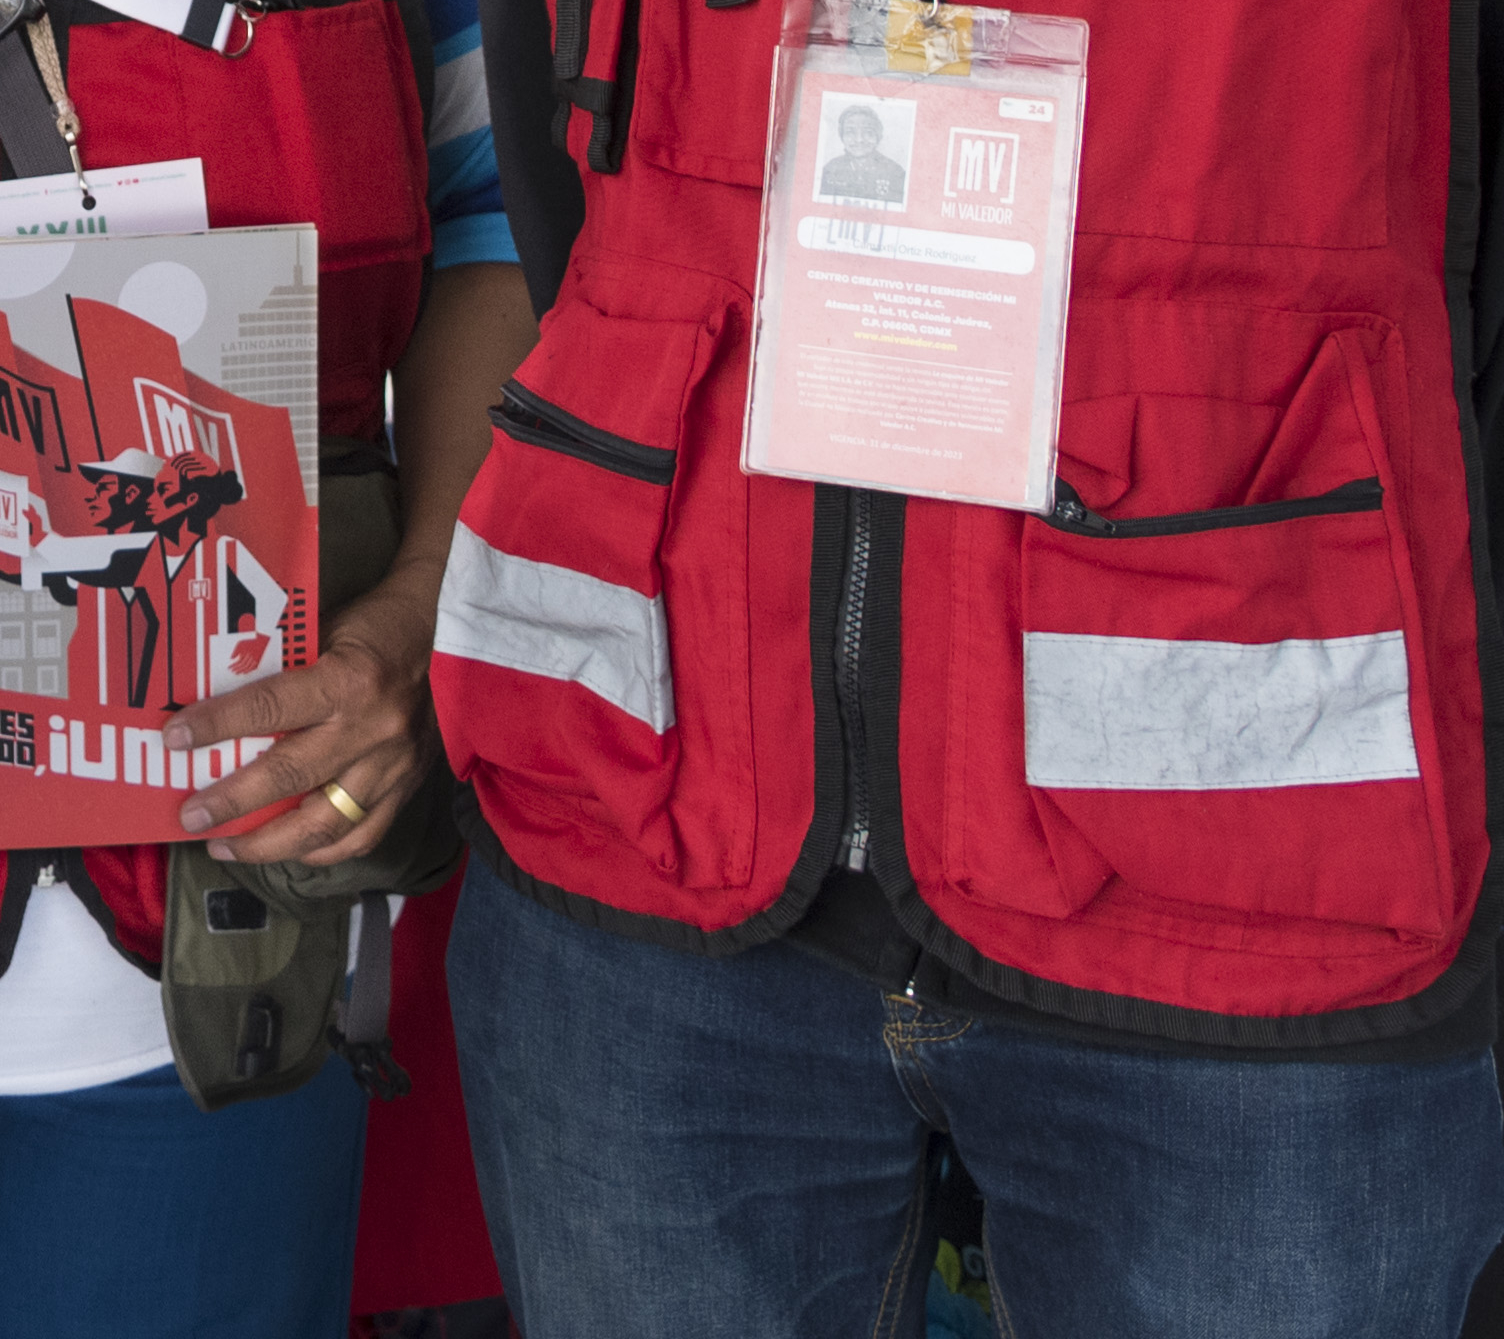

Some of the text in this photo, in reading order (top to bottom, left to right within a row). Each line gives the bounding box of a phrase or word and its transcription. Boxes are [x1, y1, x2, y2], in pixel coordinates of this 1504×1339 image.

[957, 138, 1006, 193] MV
[941, 201, 1014, 225] MI VALEDOR
[807, 270, 1002, 304] CENTRO CREATIVO REINSERCIÓN
[873, 291, 923, 307] VALEDOR
[825, 298, 993, 330] Atenas Colonia Juárez,
[854, 330, 958, 352] www.mivaledor.com
[920, 325, 952, 338] CDMX
[220, 336, 317, 354] LATINOAMERIC
[152, 393, 221, 466] MV
[892, 441, 930, 456] diciembre
